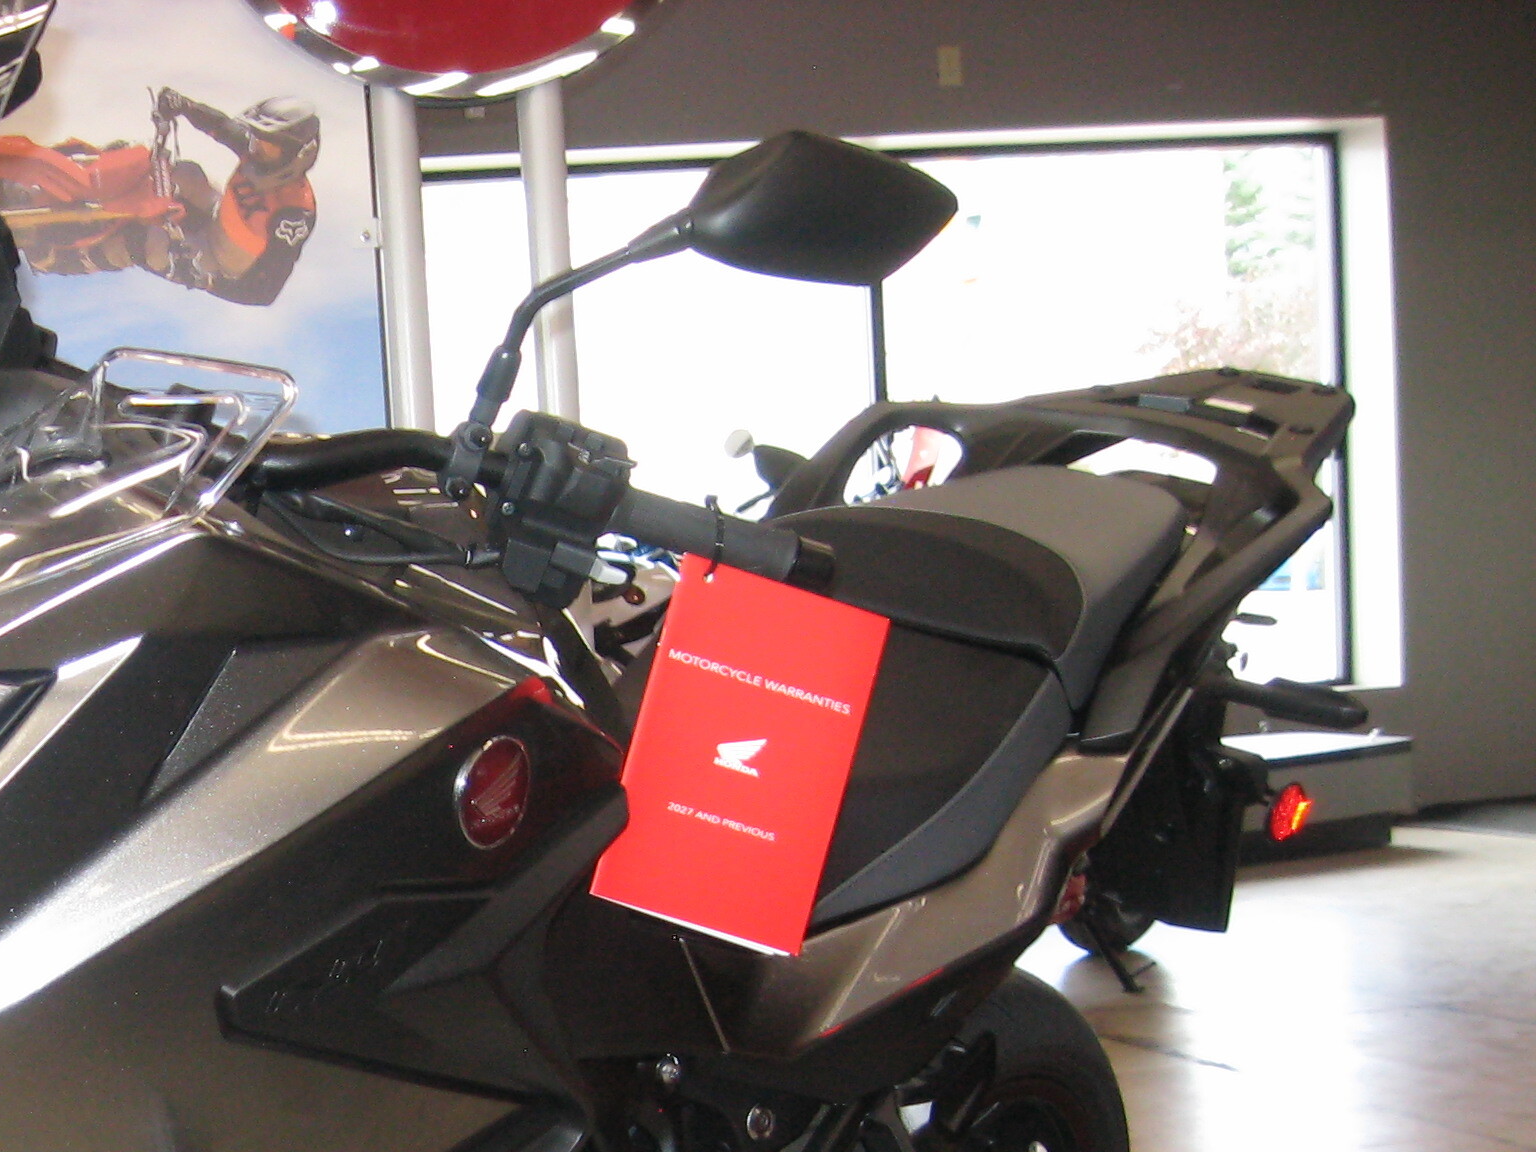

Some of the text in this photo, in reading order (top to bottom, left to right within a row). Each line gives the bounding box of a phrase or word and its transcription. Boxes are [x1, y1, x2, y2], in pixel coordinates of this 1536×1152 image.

[668, 649, 851, 716] MOTORCYCLE WARRANTIES
[713, 757, 759, 778] HONDA
[694, 811, 721, 824] AND
[722, 818, 775, 841] PREVIOUS
